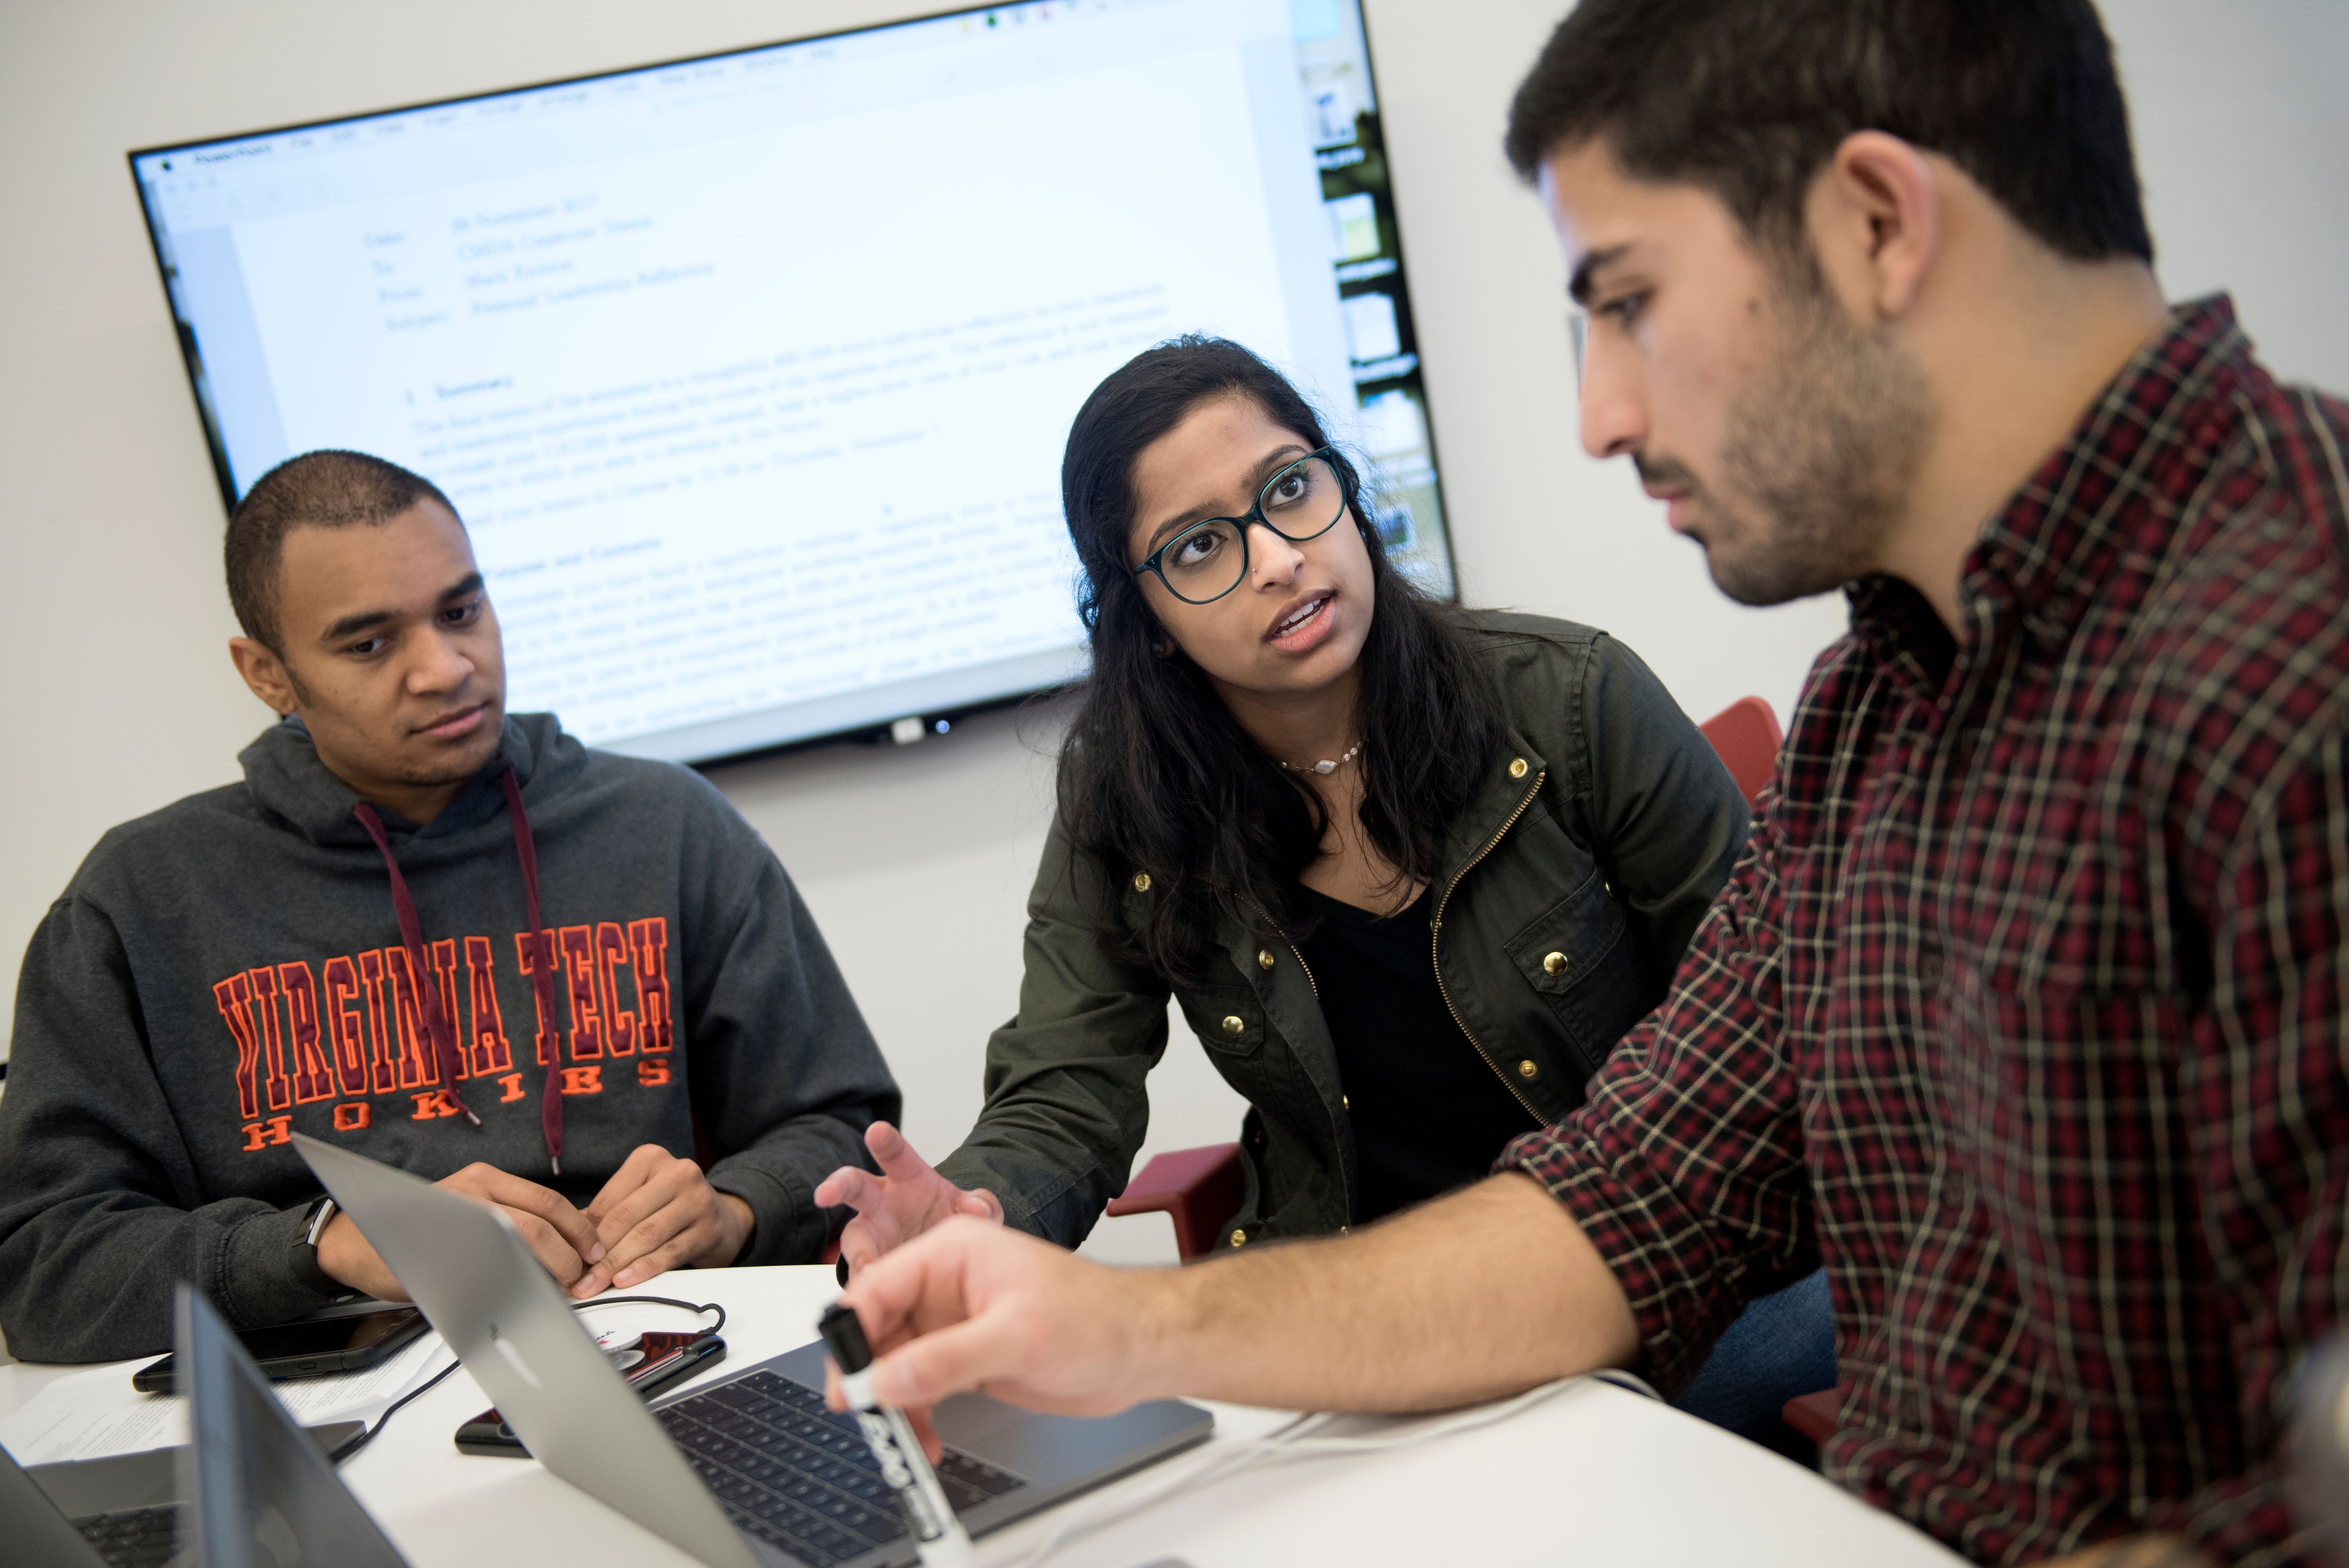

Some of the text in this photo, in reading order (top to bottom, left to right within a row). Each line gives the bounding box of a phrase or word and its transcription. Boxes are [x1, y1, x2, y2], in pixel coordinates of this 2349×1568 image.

[213, 916, 674, 1120] VIRGINIA TECH
[241, 1057, 672, 1151] HOKIES
